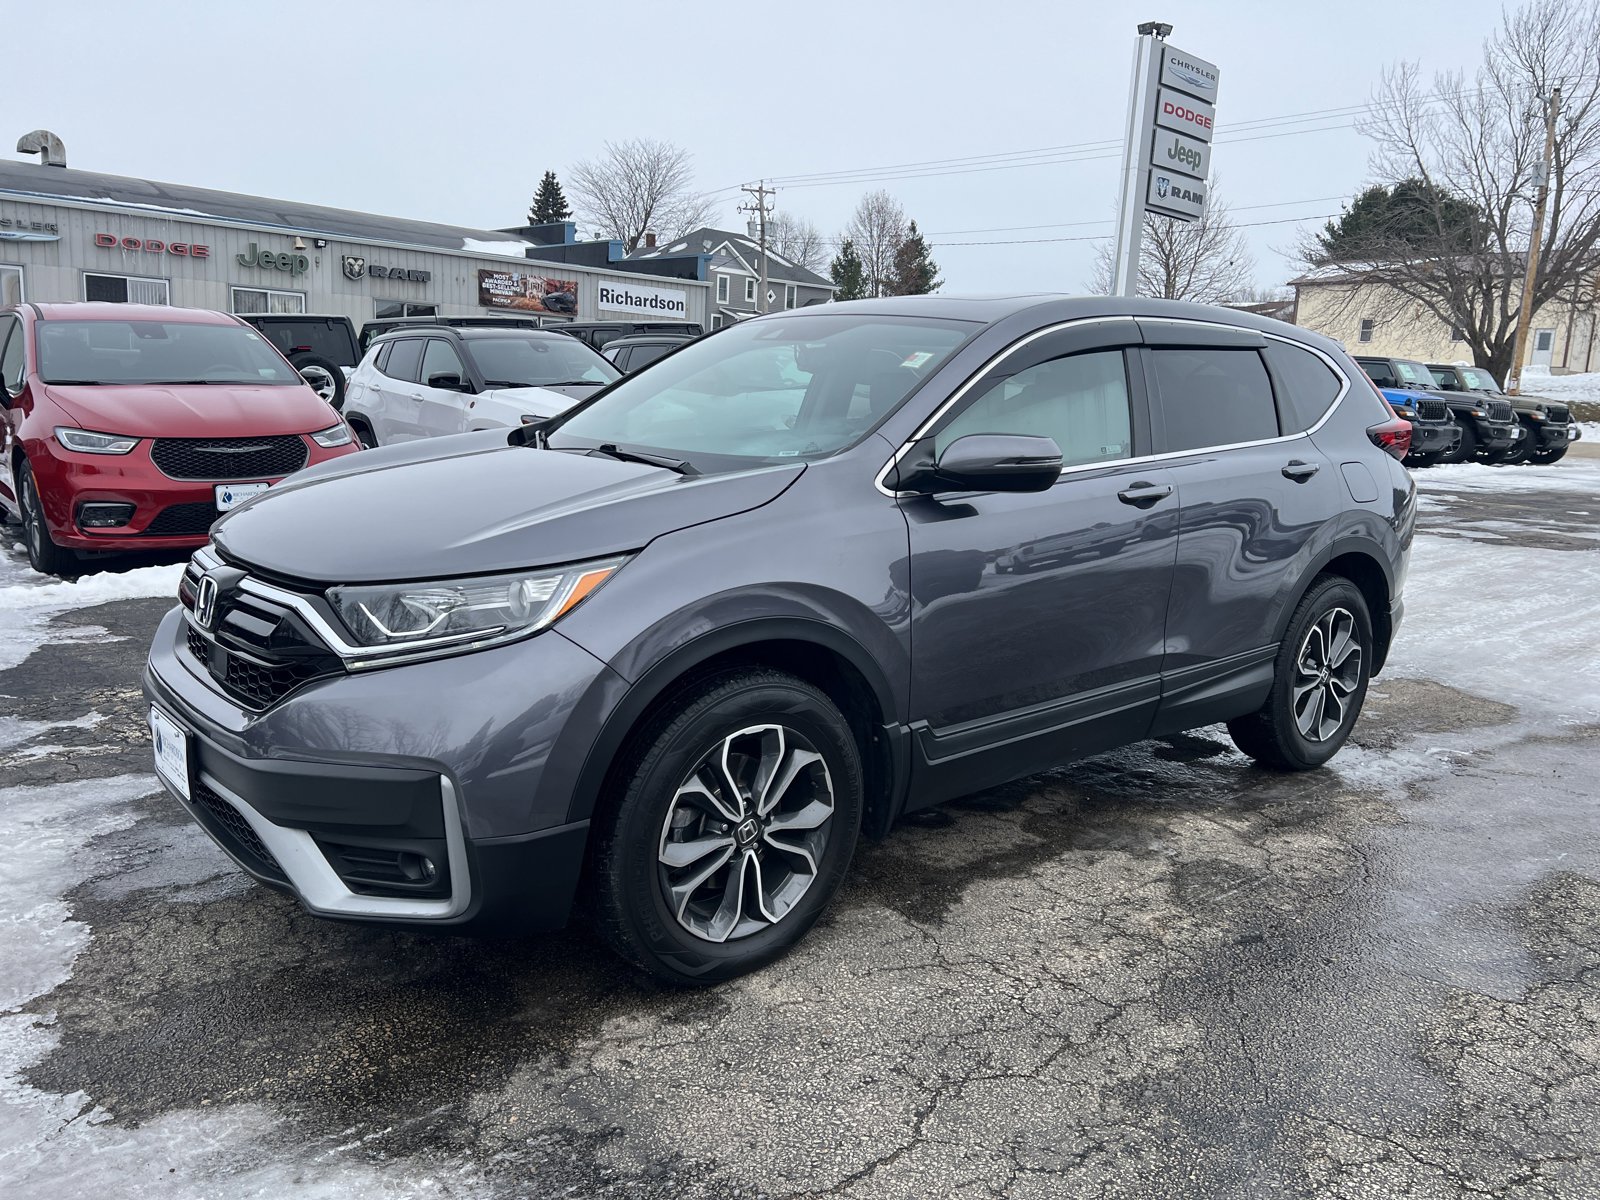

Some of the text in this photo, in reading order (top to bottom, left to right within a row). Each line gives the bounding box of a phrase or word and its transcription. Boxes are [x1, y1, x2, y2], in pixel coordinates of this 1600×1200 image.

[1170, 57, 1216, 81] CHRYSLER
[1163, 102, 1212, 129] DODGE
[1168, 138, 1202, 171] Jeep
[1171, 185, 1204, 205] RAM
[95, 233, 210, 257] DODGE
[236, 242, 309, 276] Jeep
[369, 265, 431, 282] RAM
[485, 278, 513, 286] AWARDED
[482, 282, 520, 292] BEST-SELLING
[600, 287, 684, 311] Richardson
